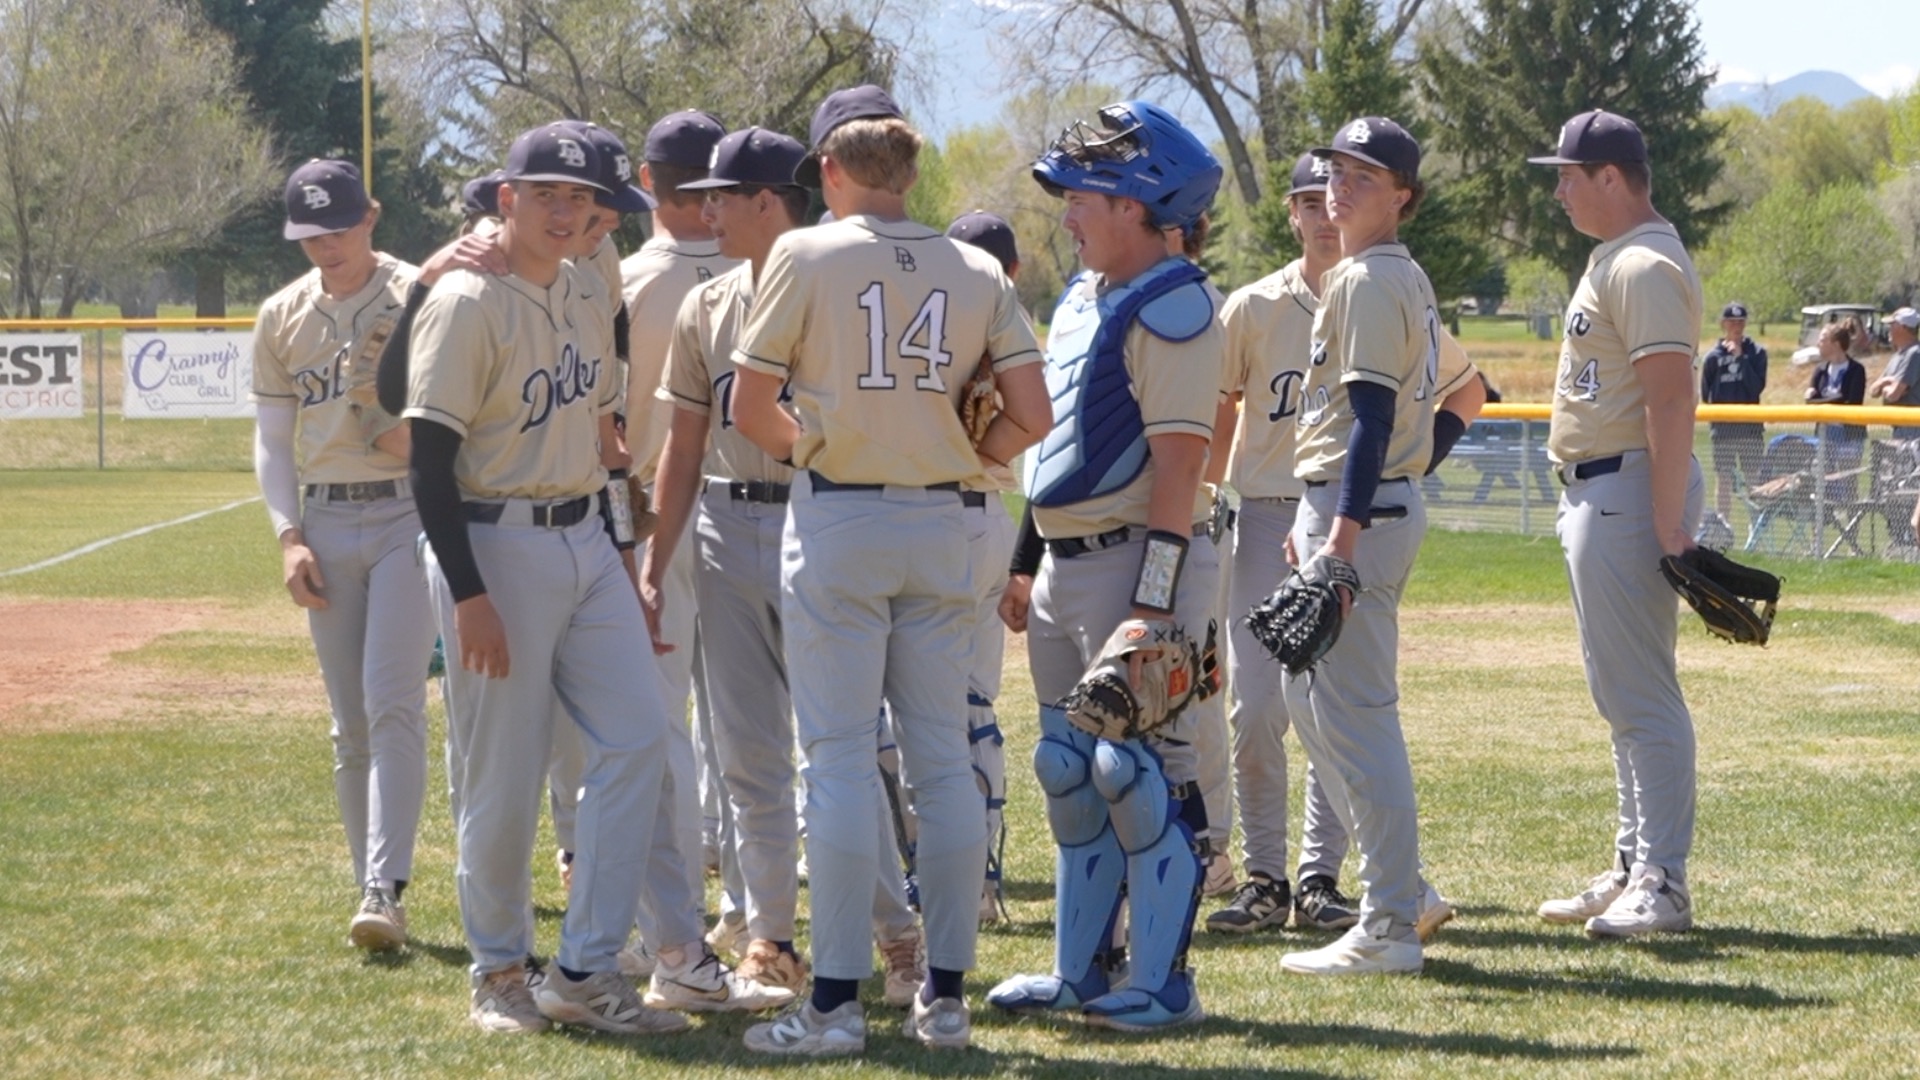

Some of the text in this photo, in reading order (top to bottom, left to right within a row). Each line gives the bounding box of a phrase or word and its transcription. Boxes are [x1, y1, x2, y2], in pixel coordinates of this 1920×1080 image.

[857, 281, 953, 394] 14
[0, 345, 78, 386] ST
[132, 338, 240, 392] Cranny's
[168, 374, 200, 387] CLUB
[197, 385, 231, 398] GRILL
